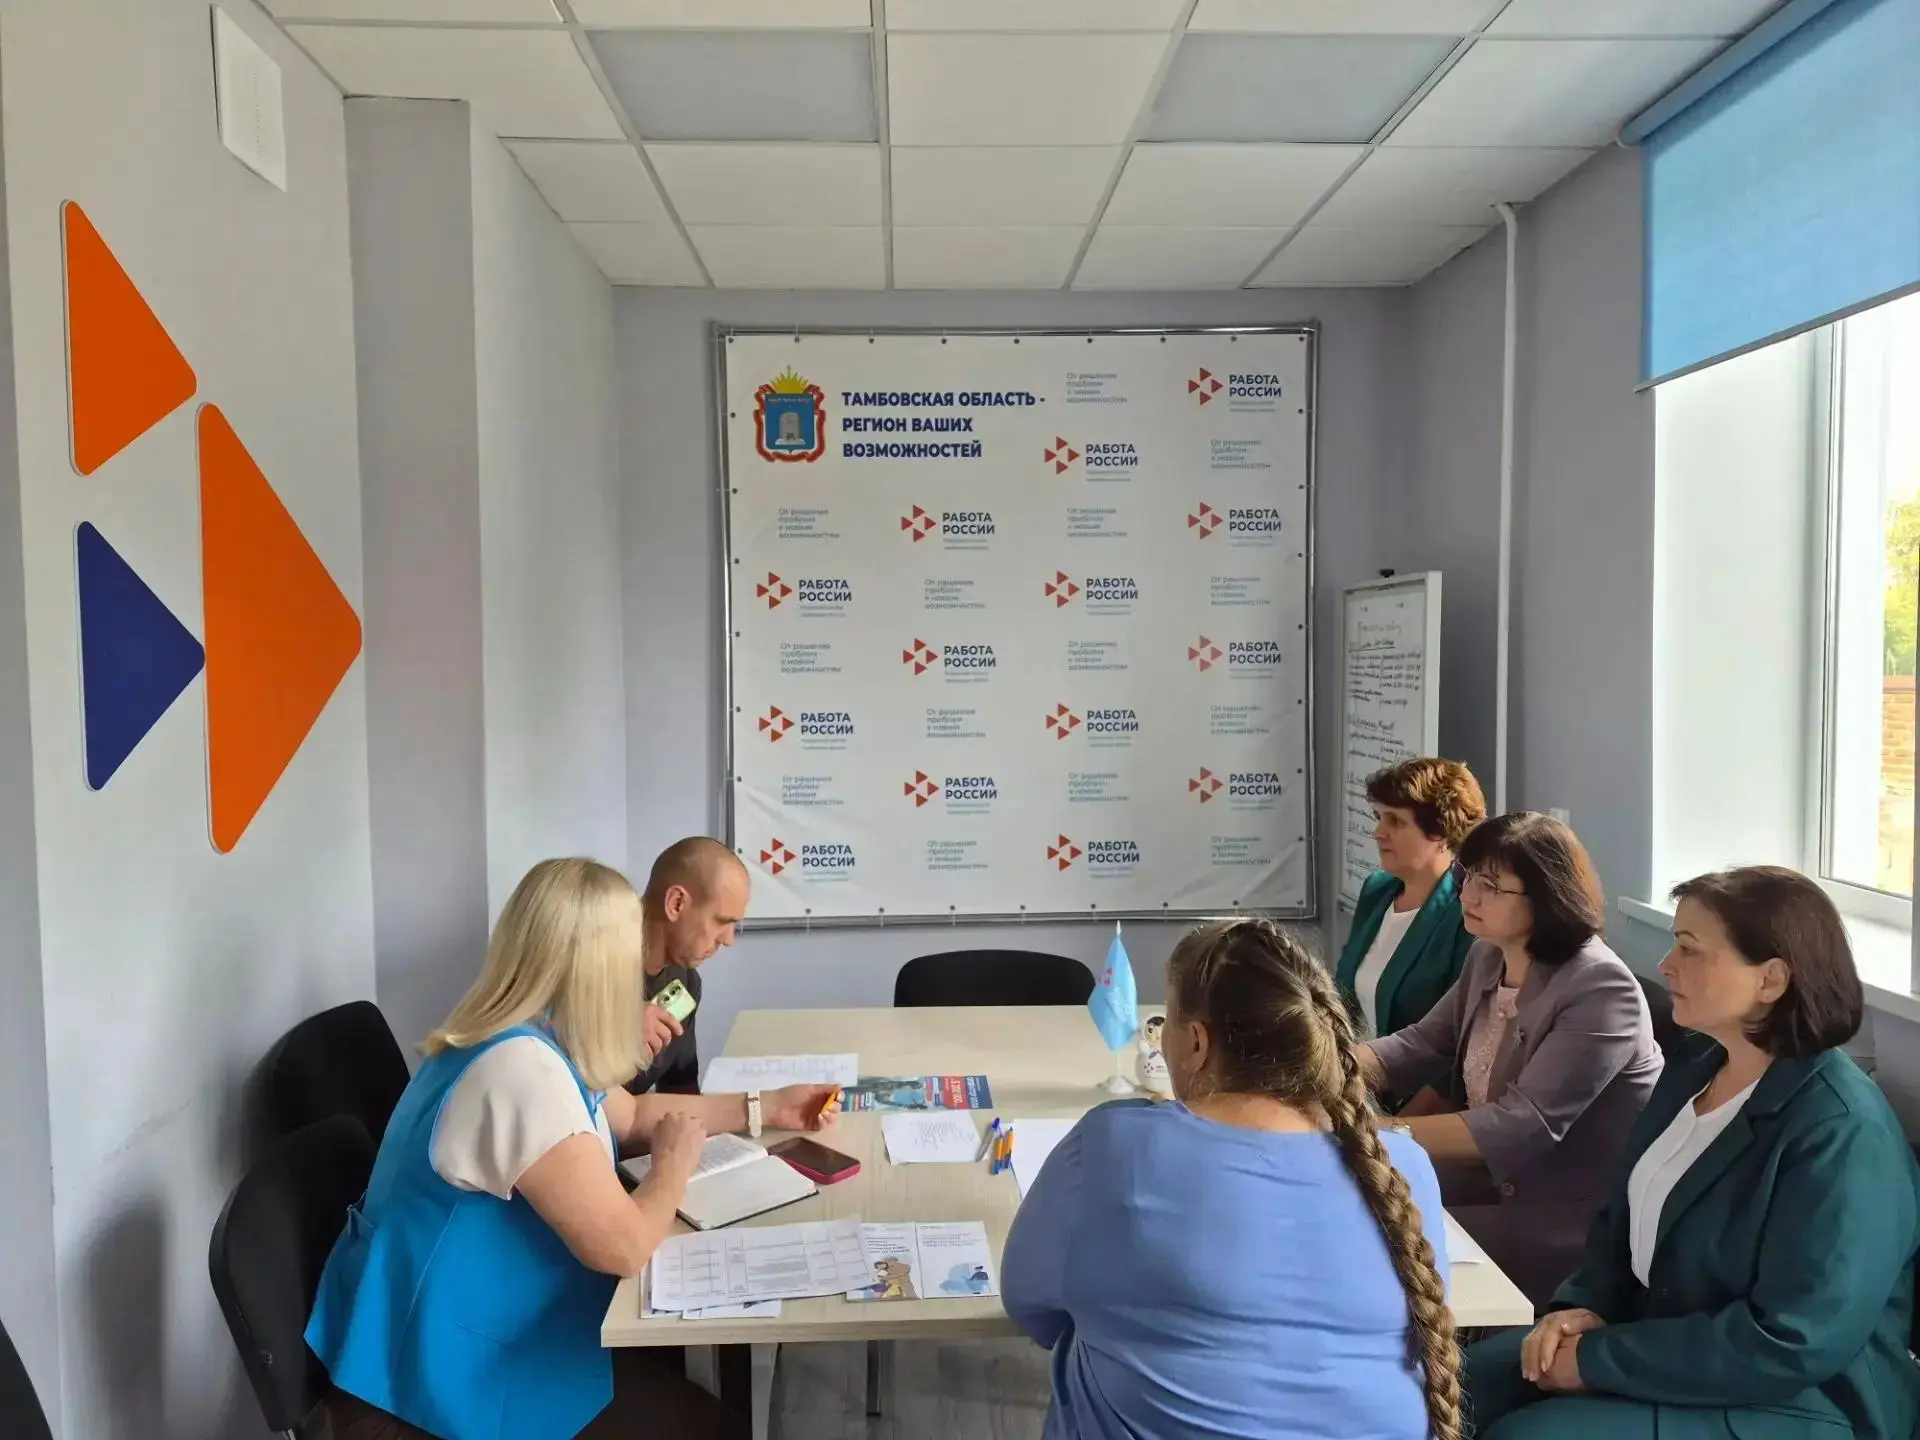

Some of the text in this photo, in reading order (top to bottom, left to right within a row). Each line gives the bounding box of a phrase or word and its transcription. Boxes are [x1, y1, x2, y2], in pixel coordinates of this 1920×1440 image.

[1229, 374, 1280, 385] РАБОТА
[1229, 386, 1282, 398] РОССИИ
[841, 391, 954, 407] ТАМБОВСКАЯ
[958, 391, 1036, 407] ОБЛАСТЬ
[842, 417, 974, 432] РЕГИОН ВАШИХ
[842, 440, 982, 458] ВОЗМОЖНОСТЕЙ
[1085, 443, 1136, 454] РАБОТА
[1085, 456, 1138, 467] РОССИИ
[942, 511, 993, 523] РАБОТА
[1229, 508, 1280, 520] РАБОТА
[942, 524, 995, 535] РОССИИ
[1229, 520, 1282, 532] РОССИИ
[798, 579, 849, 590] РАБОТА
[1086, 577, 1136, 589] РАБОТА
[799, 591, 853, 602] РОССИИ
[1086, 589, 1139, 601] РОССИИ
[943, 645, 994, 656] РАБОТА
[1228, 641, 1279, 652] РАБОТА
[943, 657, 997, 668] РОССИИ
[1229, 653, 1282, 664] РОССИИ
[800, 712, 851, 723] РАБОТА
[1086, 709, 1137, 720] РАБОТА
[800, 724, 854, 735] РОССИИ
[1086, 721, 1139, 732] РОССИИ
[944, 776, 995, 788] РАБОТА
[1229, 772, 1279, 784] РАБОТА
[945, 789, 998, 800] РОССИИ
[1229, 785, 1282, 796] РОССИИ
[802, 844, 853, 856] РАБОТА
[1087, 840, 1138, 852] РАБОТА
[802, 856, 855, 868] РОССИИ
[1087, 852, 1140, 863] РОССИИ
